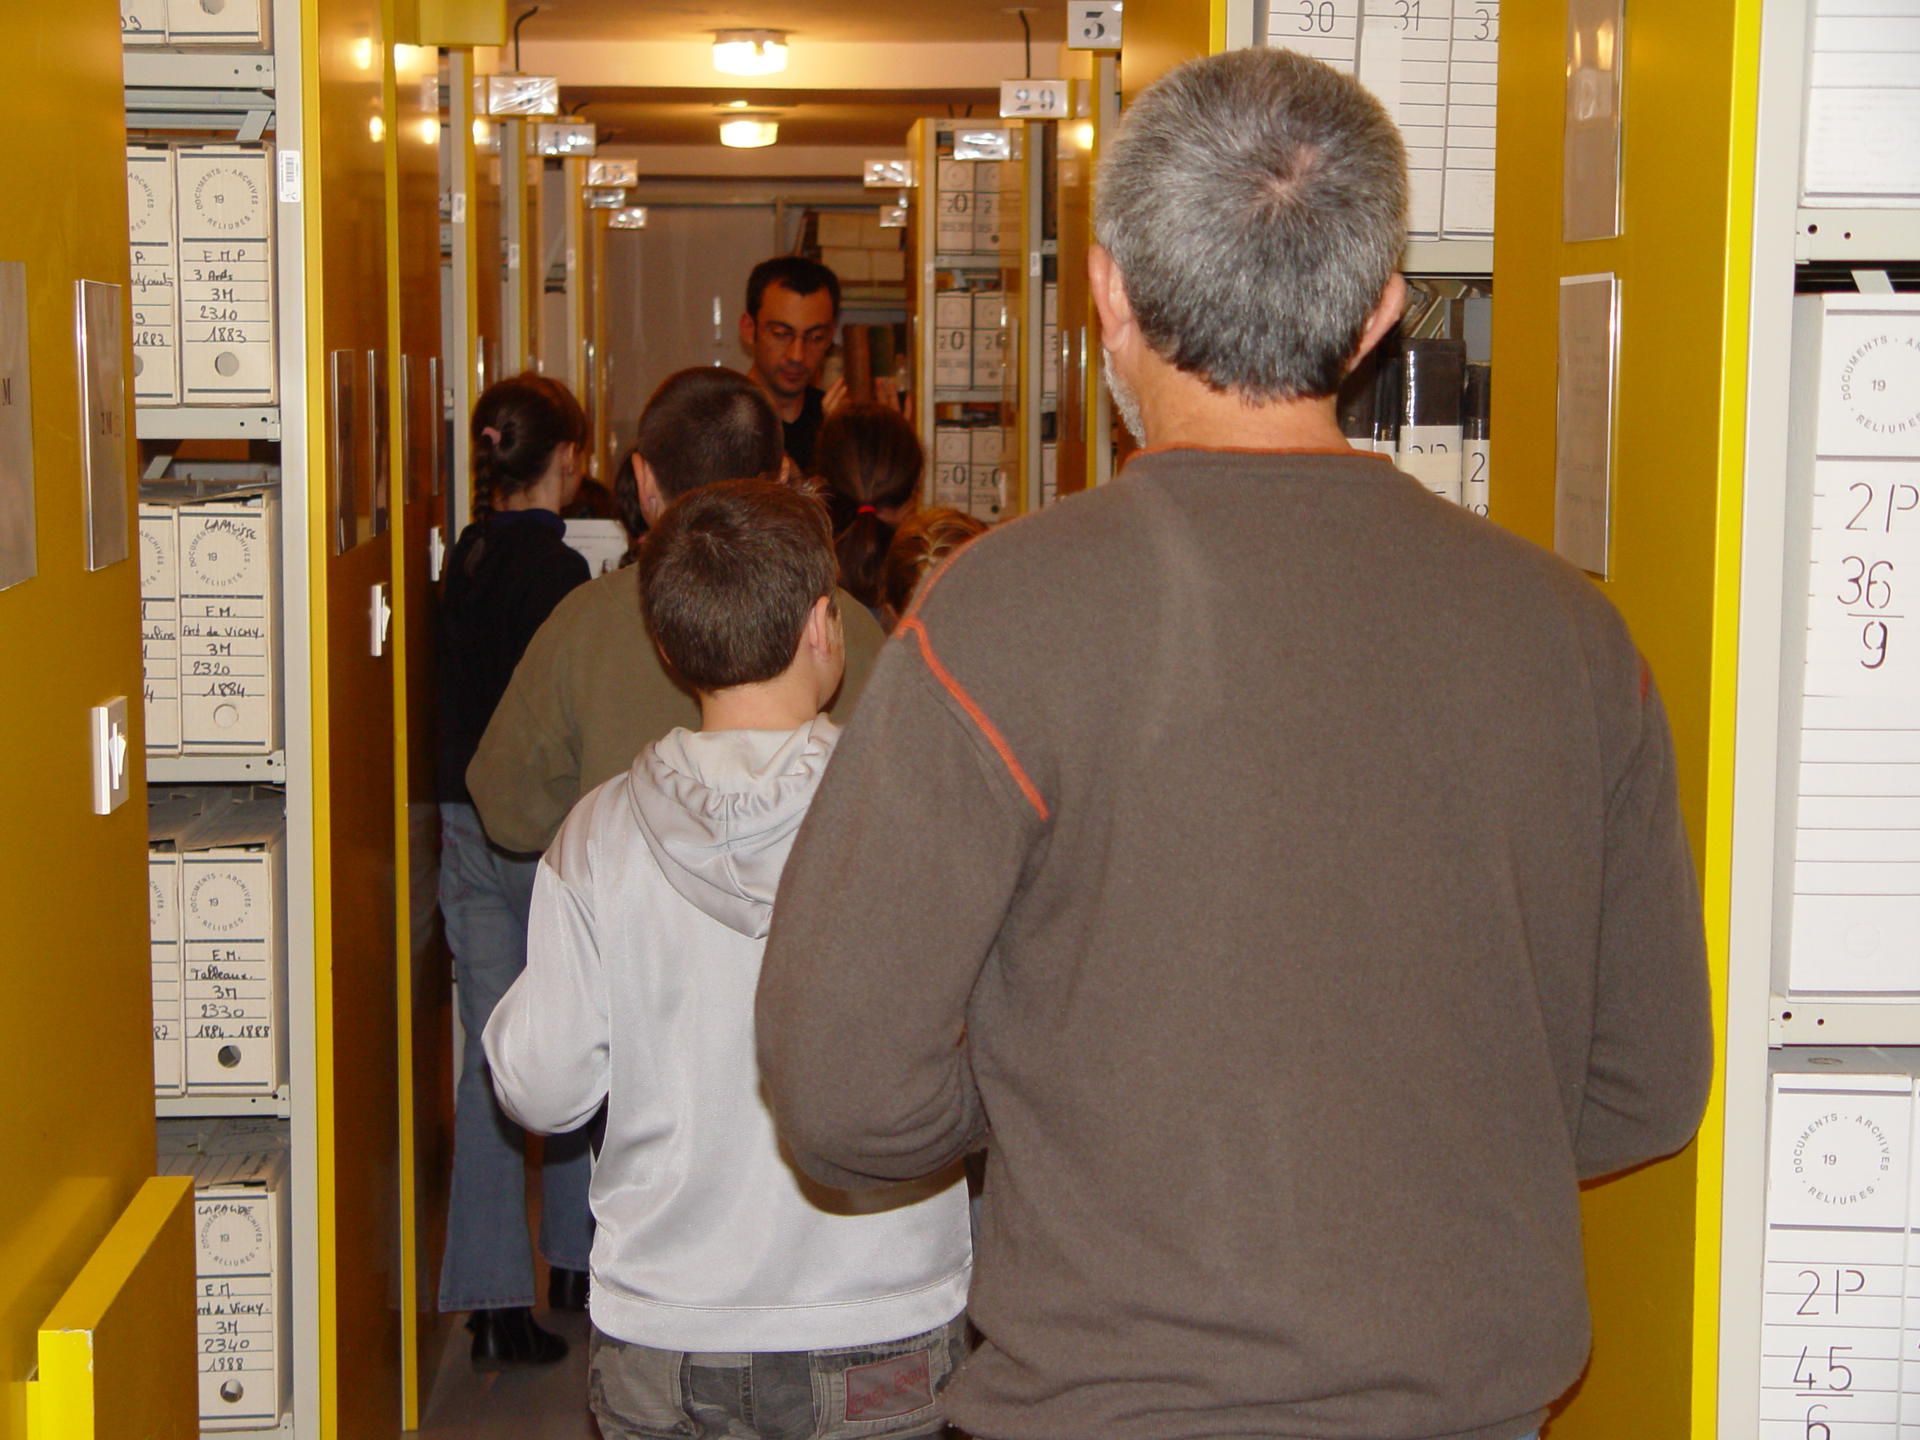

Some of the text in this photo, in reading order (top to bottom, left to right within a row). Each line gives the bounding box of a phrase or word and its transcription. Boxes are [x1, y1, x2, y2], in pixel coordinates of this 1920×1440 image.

[1298, 0, 1335, 33] 30
[1395, 0, 1420, 32] 31
[195, 167, 221, 210] DOCUMENTS
[232, 168, 258, 205] ARCHIVES
[206, 215, 251, 230] RELIURES
[193, 269, 201, 281] 3
[200, 305, 238, 321] 2310
[202, 326, 247, 343] 1883
[1841, 335, 1888, 401] DOCUMENTS
[1871, 379, 1887, 392] 19
[1845, 482, 1920, 534] 2P
[207, 552, 218, 561] 19
[200, 572, 243, 587] RELIURES
[1837, 556, 1894, 610] 36
[1860, 621, 1888, 670] 9
[192, 661, 231, 676] 2320
[190, 873, 251, 913] DOCUMENTS ARCHIVES
[202, 917, 244, 931] RELIURES
[201, 1003, 245, 1018] 2330
[1793, 1113, 1890, 1174] DOCUMENTS ARCHIVES
[1822, 1153, 1837, 1166] 19
[1807, 1185, 1875, 1206] RELIURES
[213, 1251, 256, 1266] RELIURES
[1796, 1269, 1865, 1316] 2P
[204, 1338, 250, 1353] 2340
[207, 1357, 244, 1373] 1888
[1793, 1345, 1853, 1391] 45
